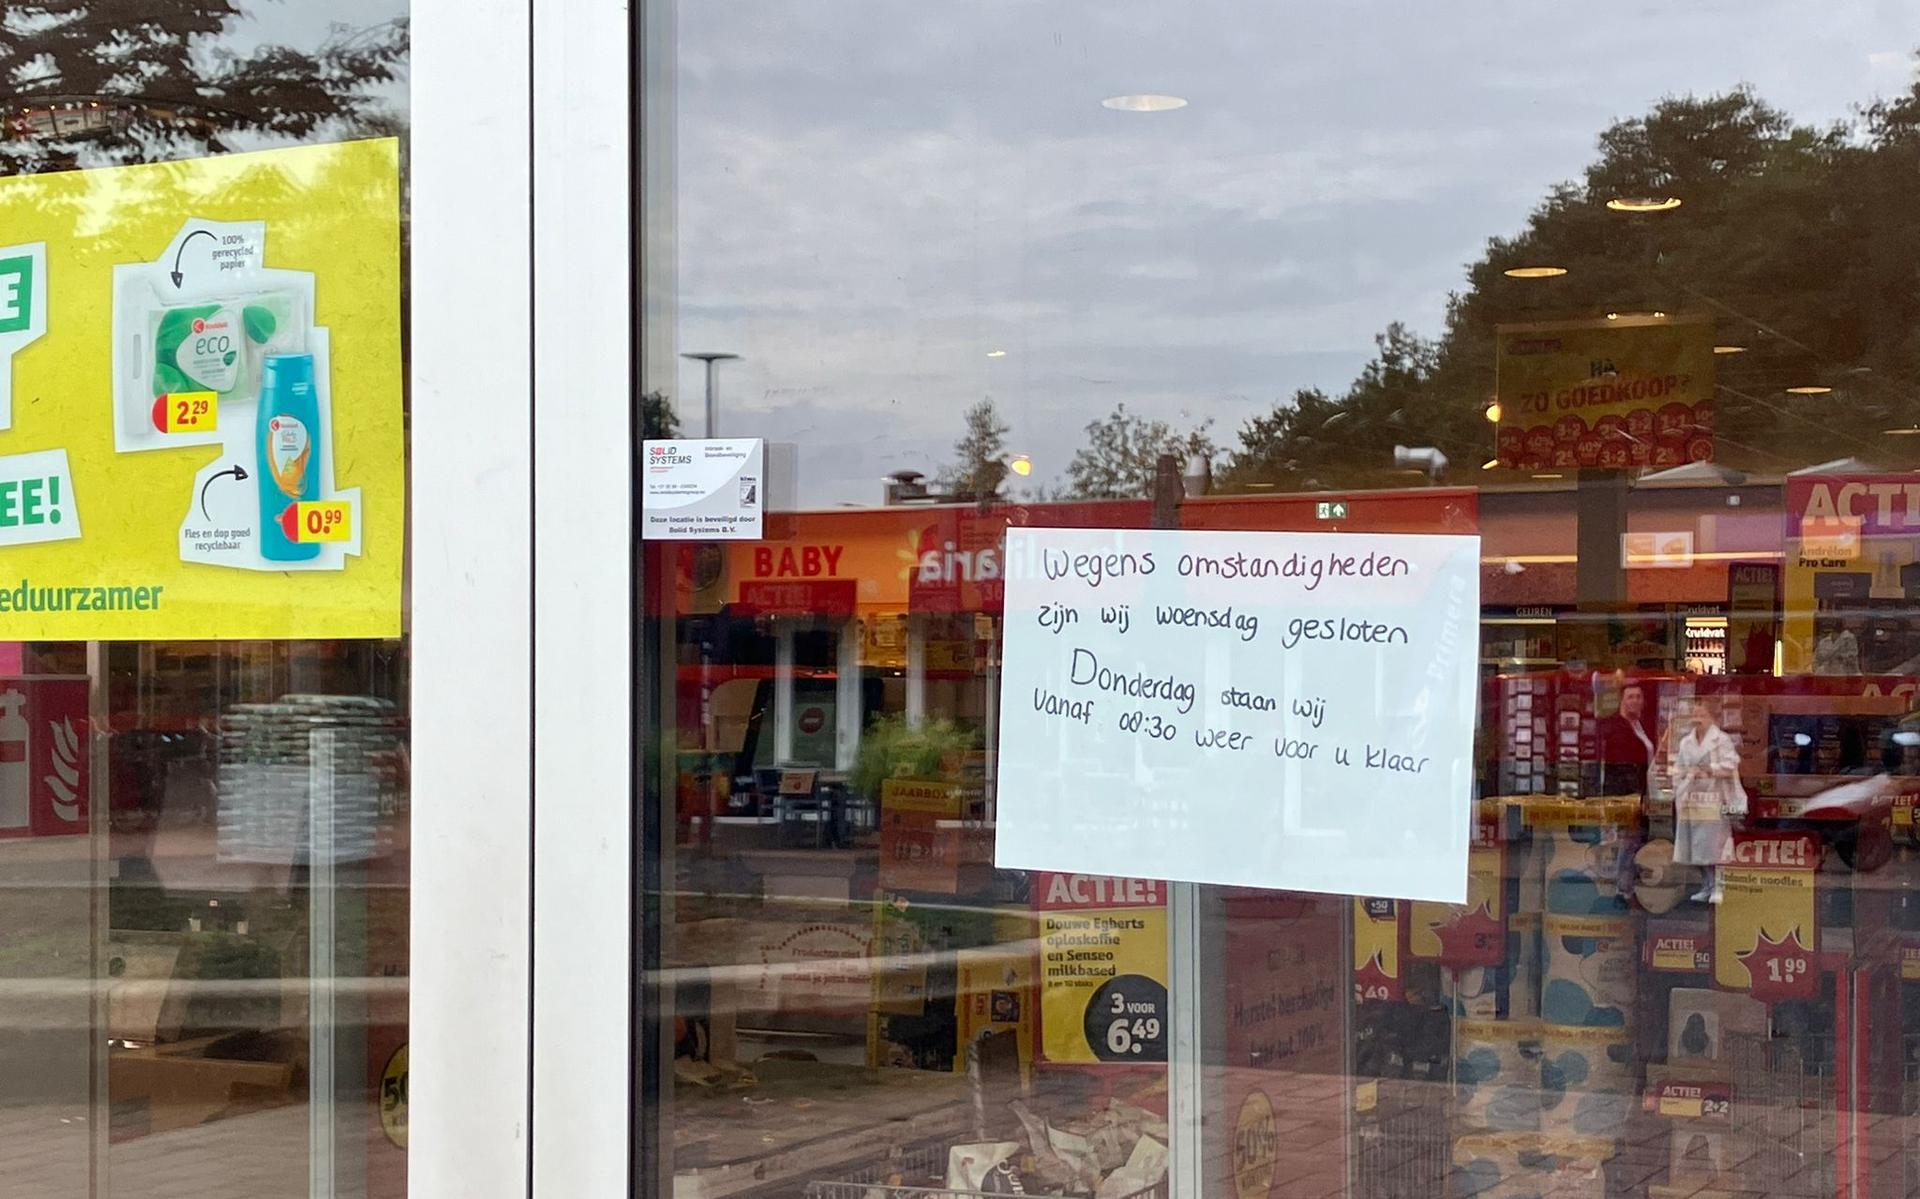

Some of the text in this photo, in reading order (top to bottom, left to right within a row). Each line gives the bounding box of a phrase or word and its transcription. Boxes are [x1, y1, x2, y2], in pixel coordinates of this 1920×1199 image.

[222, 235, 245, 246] 100%
[211, 246, 254, 260] gerecycled
[219, 259, 246, 271] papier
[195, 335, 230, 356] eco
[177, 400, 209, 425] 2.29
[649, 447, 677, 456] SOLID
[649, 455, 692, 465] SYSTEMS
[307, 509, 342, 534] 0.99
[202, 531, 213, 539] en
[213, 528, 230, 541] dop
[231, 528, 251, 541] goed
[689, 526, 720, 535] Systems
[195, 540, 241, 553] recyclebaar
[754, 545, 844, 577] BABY
[1799, 557, 1847, 568] Pro Care
[1043, 547, 1410, 591] Wegens omstandigheden
[1515, 606, 1553, 618] GEUREN
[1037, 600, 1409, 649] zijn wij woensdag gesloten
[1070, 647, 1327, 728] Donderdag staan wij
[1118, 710, 1177, 741] 08:30
[1195, 727, 1253, 752] weer
[1365, 745, 1430, 775] klaar
[1719, 836, 1806, 865] ACTIE!
[1046, 873, 1158, 904] ACTIE!
[1760, 876, 1804, 887] noodles
[1046, 917, 1145, 933] Douwe Egberts
[1046, 933, 1121, 948] oploskoffie
[1655, 938, 1695, 950] ACTIE!
[1047, 950, 1114, 962] en Senseo
[1047, 964, 1117, 978] milkbased
[1766, 957, 1807, 983] 1.99
[1111, 993, 1156, 1014] 3 VOOR
[1106, 1017, 1161, 1055] 6.49
[1662, 1086, 1702, 1098] ACTIE!
[1703, 1099, 1729, 1114] 2+2
